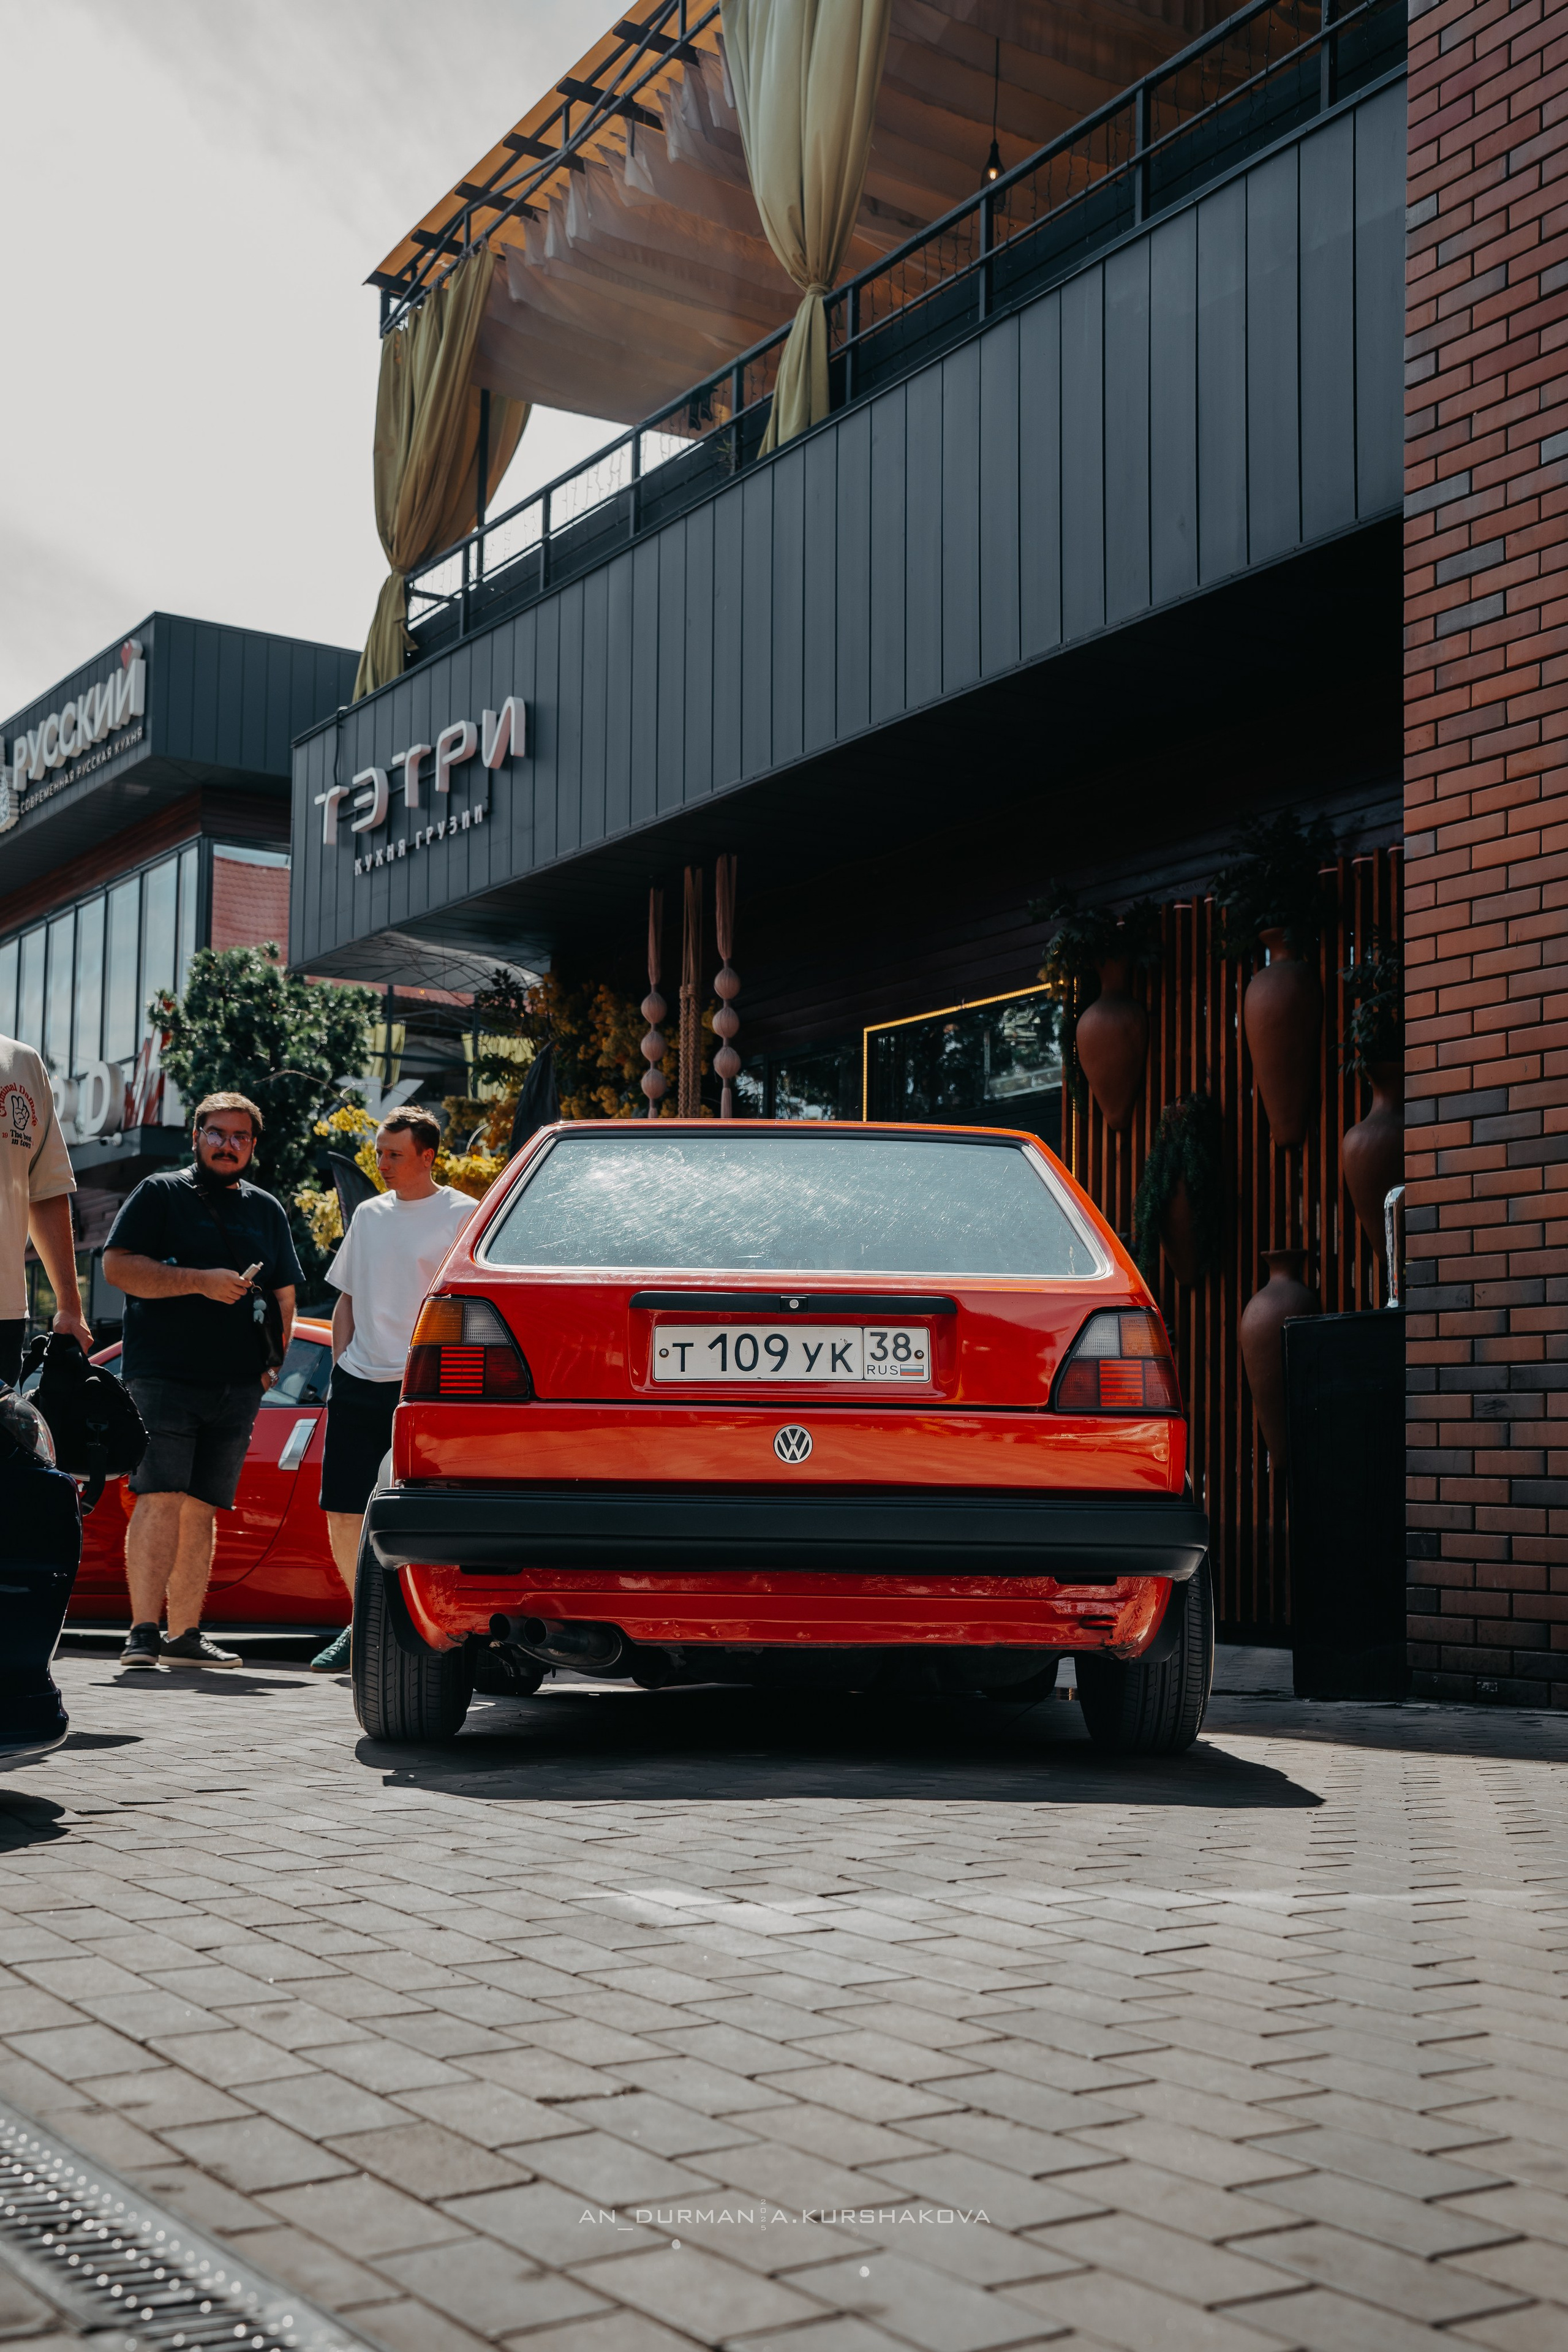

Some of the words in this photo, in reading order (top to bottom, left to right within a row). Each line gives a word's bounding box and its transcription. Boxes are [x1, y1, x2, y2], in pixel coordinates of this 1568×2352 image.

[20, 769, 74, 814] СОВРЕМЕННАЯ
[76, 745, 112, 779] РУССКАЯ
[113, 725, 143, 756] КУХНЯ
[314, 696, 526, 845] ТЭТРИ
[355, 839, 406, 876] КУХНЯ
[415, 804, 483, 850] ГРУЗИИ
[10, 1129, 23, 1139] The
[707, 1333, 789, 1373] 109
[869, 1332, 912, 1362] 38
[867, 1364, 899, 1376] RUS
